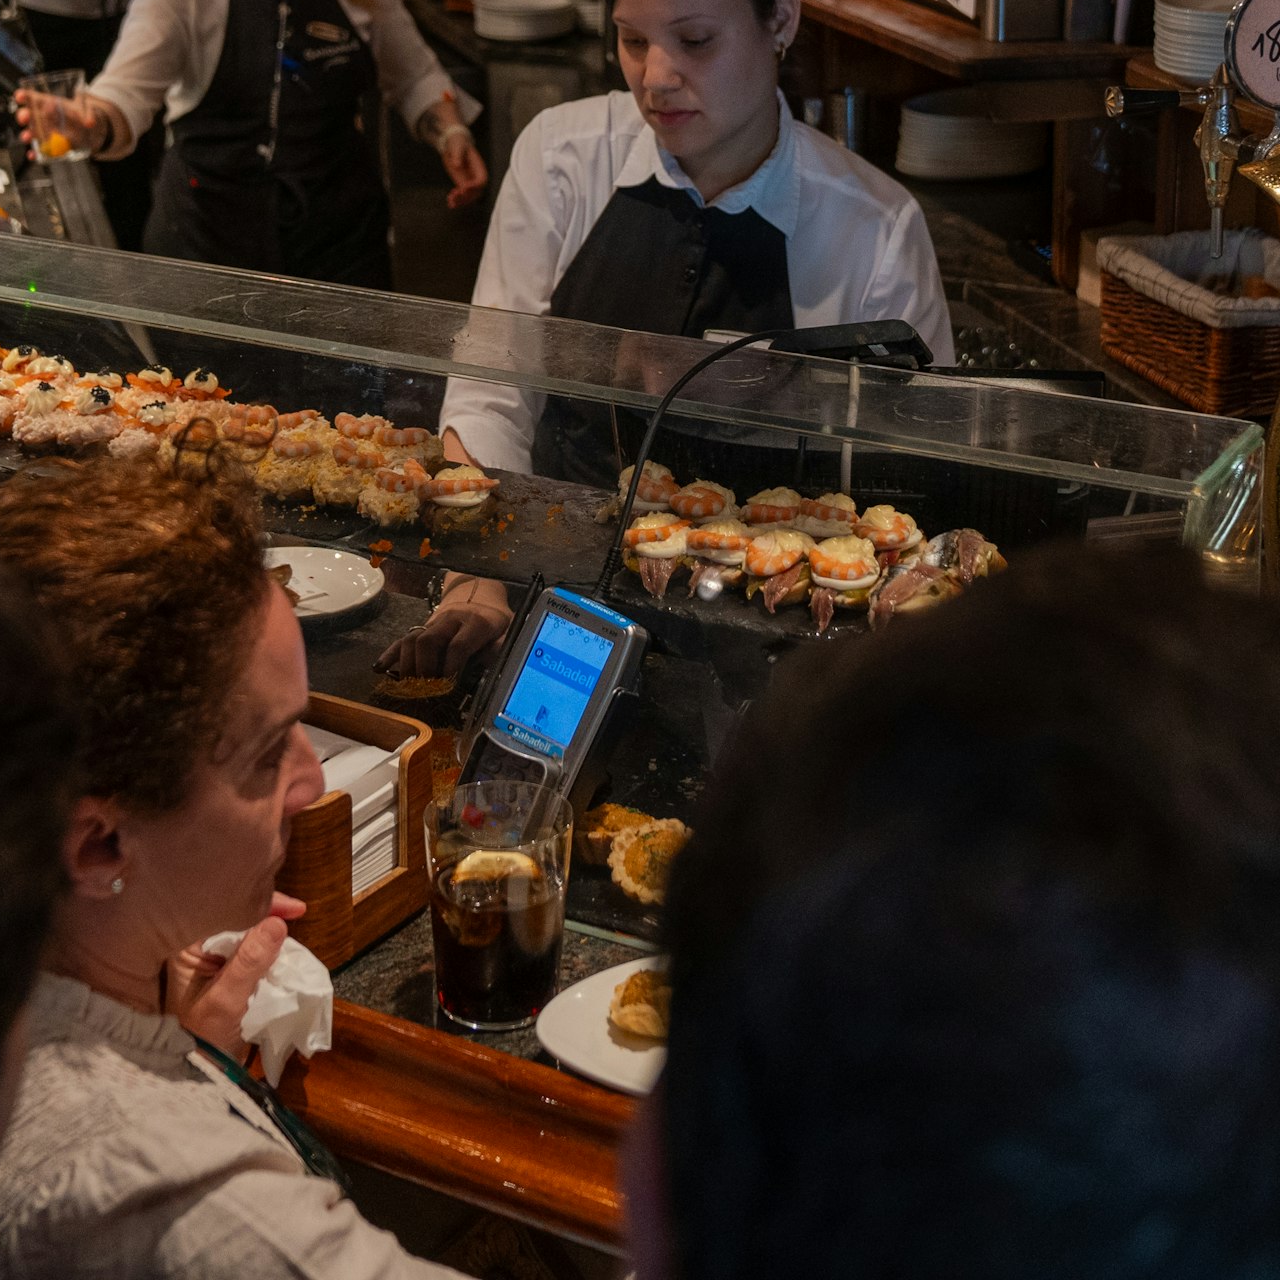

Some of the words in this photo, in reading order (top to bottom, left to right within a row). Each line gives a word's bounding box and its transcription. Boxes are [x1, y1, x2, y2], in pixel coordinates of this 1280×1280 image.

[546, 597, 581, 620] Verifone
[540, 654, 596, 690] Sabadell
[512, 725, 552, 753] Sabadell
